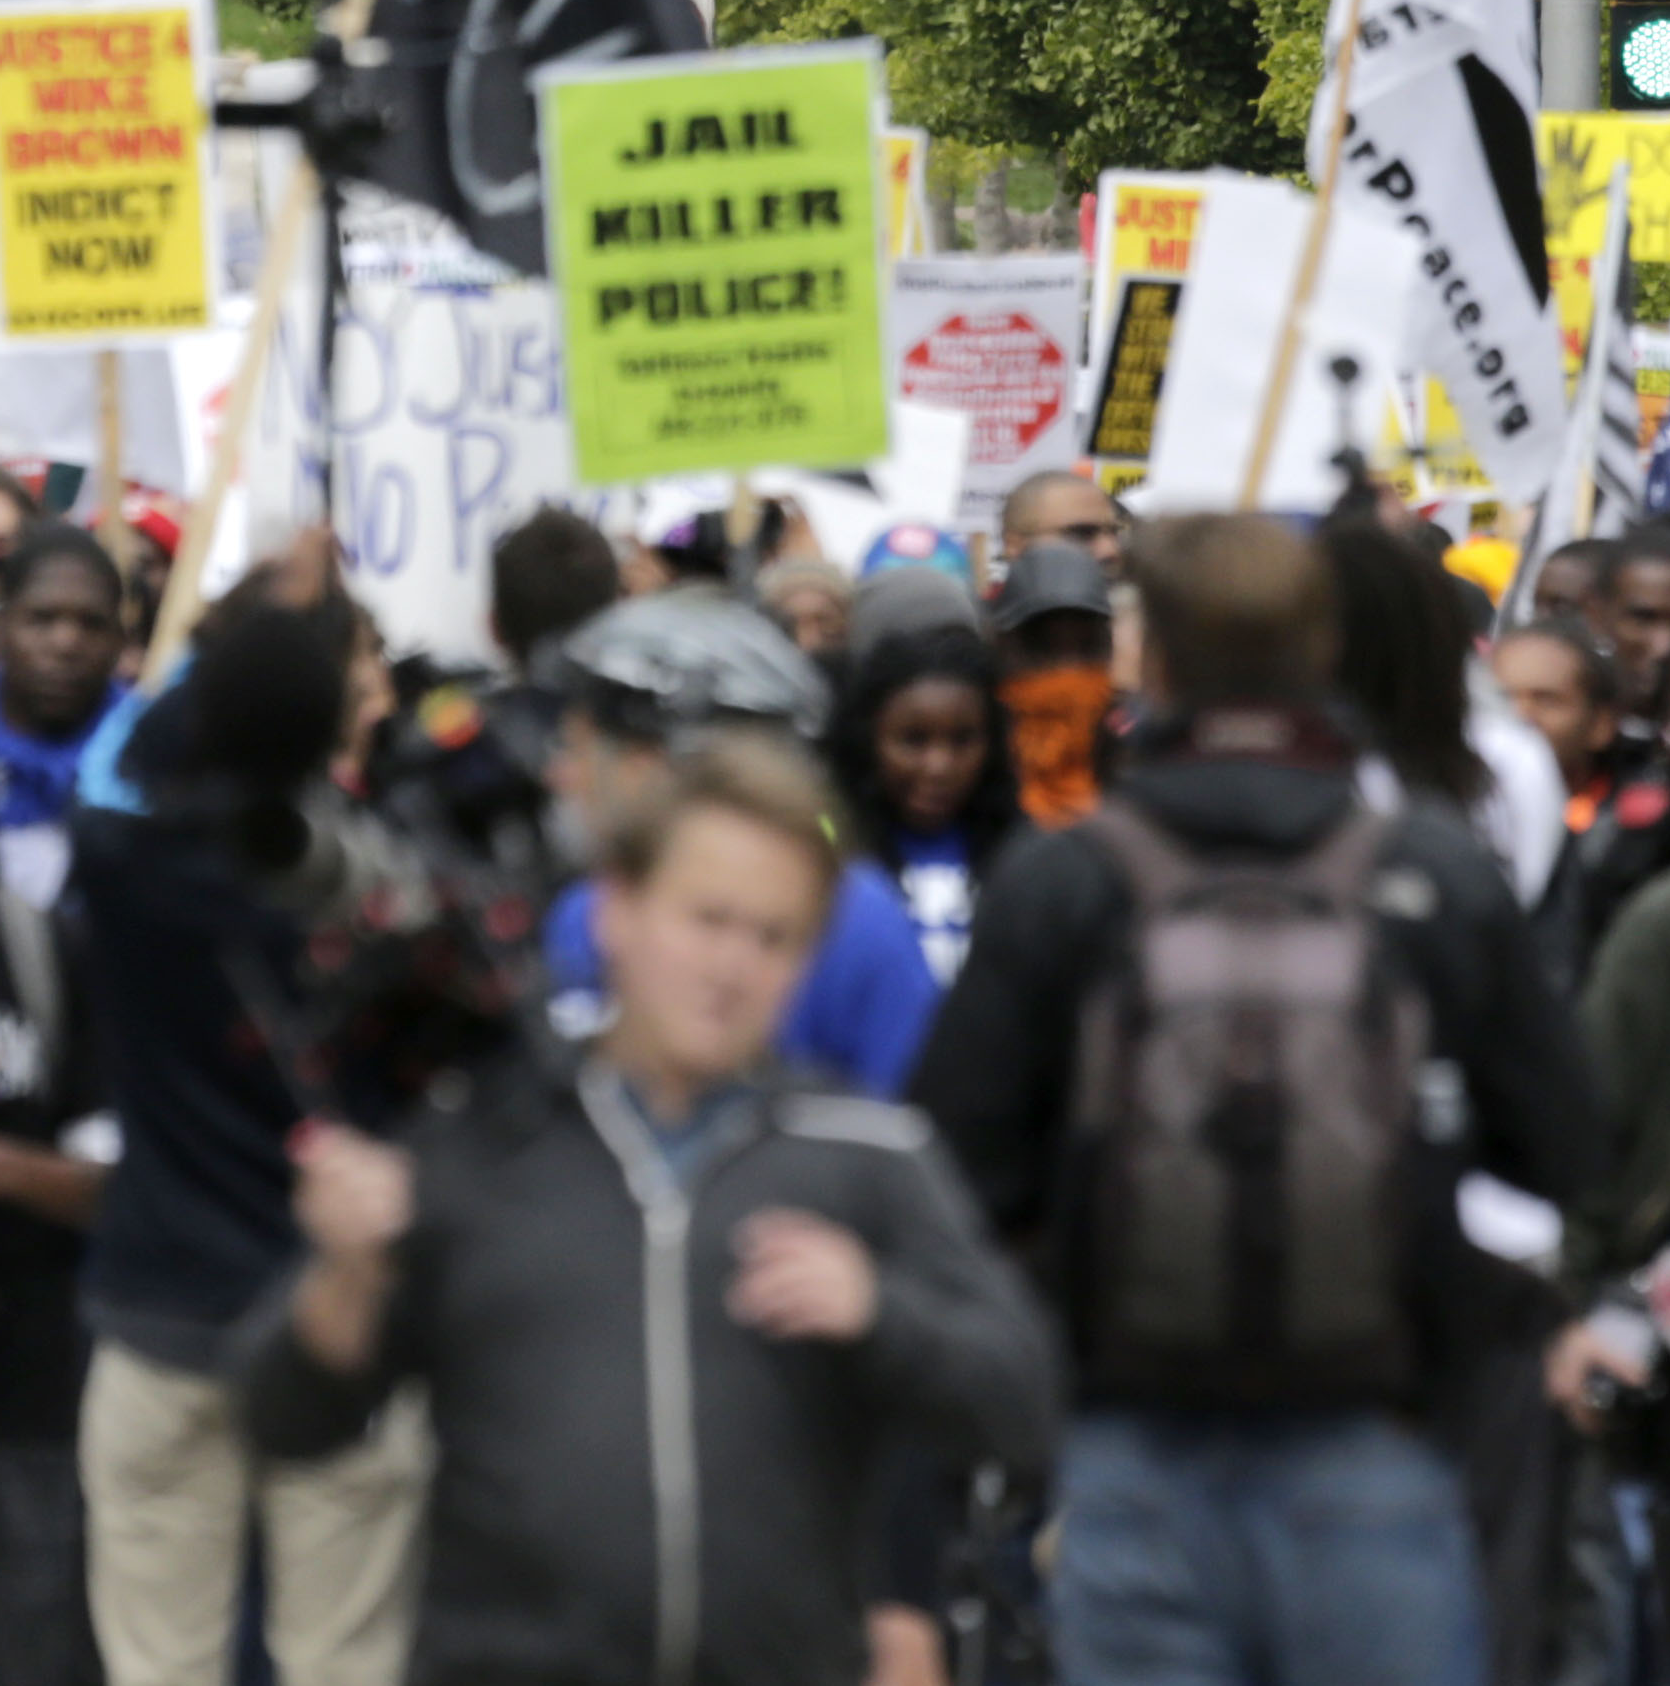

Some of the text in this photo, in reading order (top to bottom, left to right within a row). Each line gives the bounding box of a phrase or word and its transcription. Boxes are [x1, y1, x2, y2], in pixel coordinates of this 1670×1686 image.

[617, 111, 802, 168] JAIL
[588, 187, 843, 250] KILLER
[1115, 198, 1202, 233] JUST
[42, 235, 156, 278] NOW
